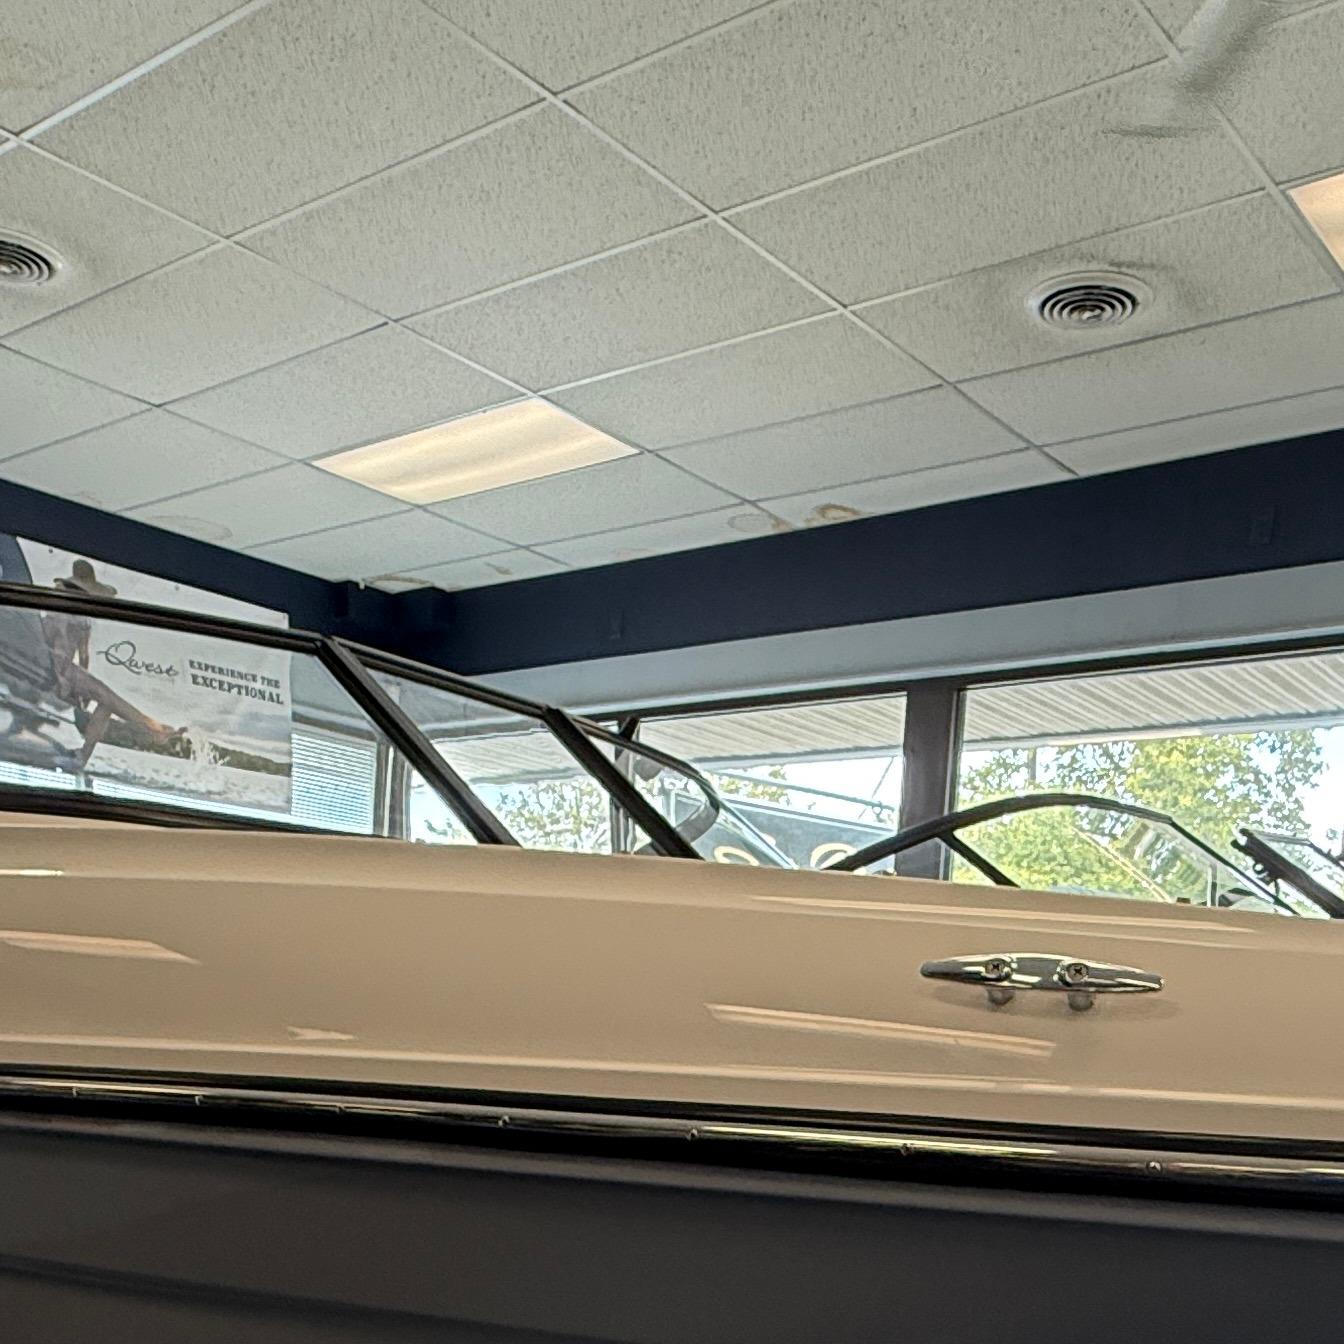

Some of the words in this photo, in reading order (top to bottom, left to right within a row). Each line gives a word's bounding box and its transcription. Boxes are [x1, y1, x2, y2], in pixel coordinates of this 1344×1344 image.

[188, 659, 258, 684] EXPERIENCE
[260, 676, 280, 689] THE
[190, 674, 284, 705] EXCEPTIONAL
